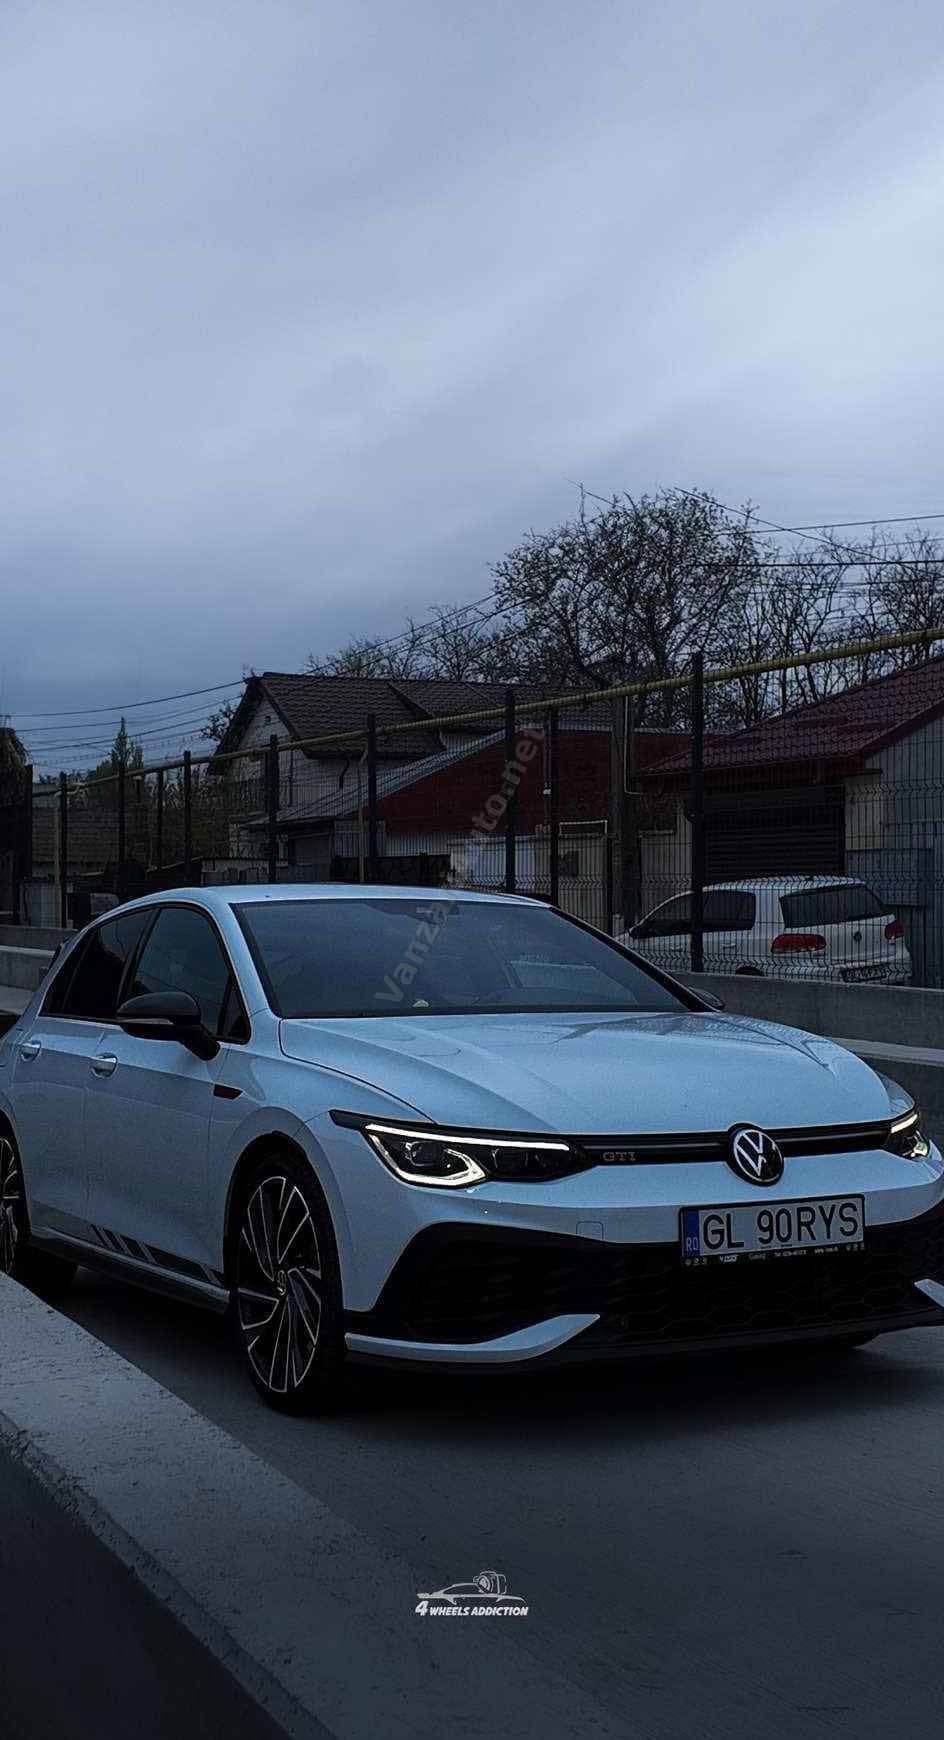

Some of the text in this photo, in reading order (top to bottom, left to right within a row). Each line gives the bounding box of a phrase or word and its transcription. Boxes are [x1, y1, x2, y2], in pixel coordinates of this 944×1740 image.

[602, 1151, 637, 1162] GTI
[703, 1213, 745, 1250] GL
[686, 1236, 699, 1252] RO
